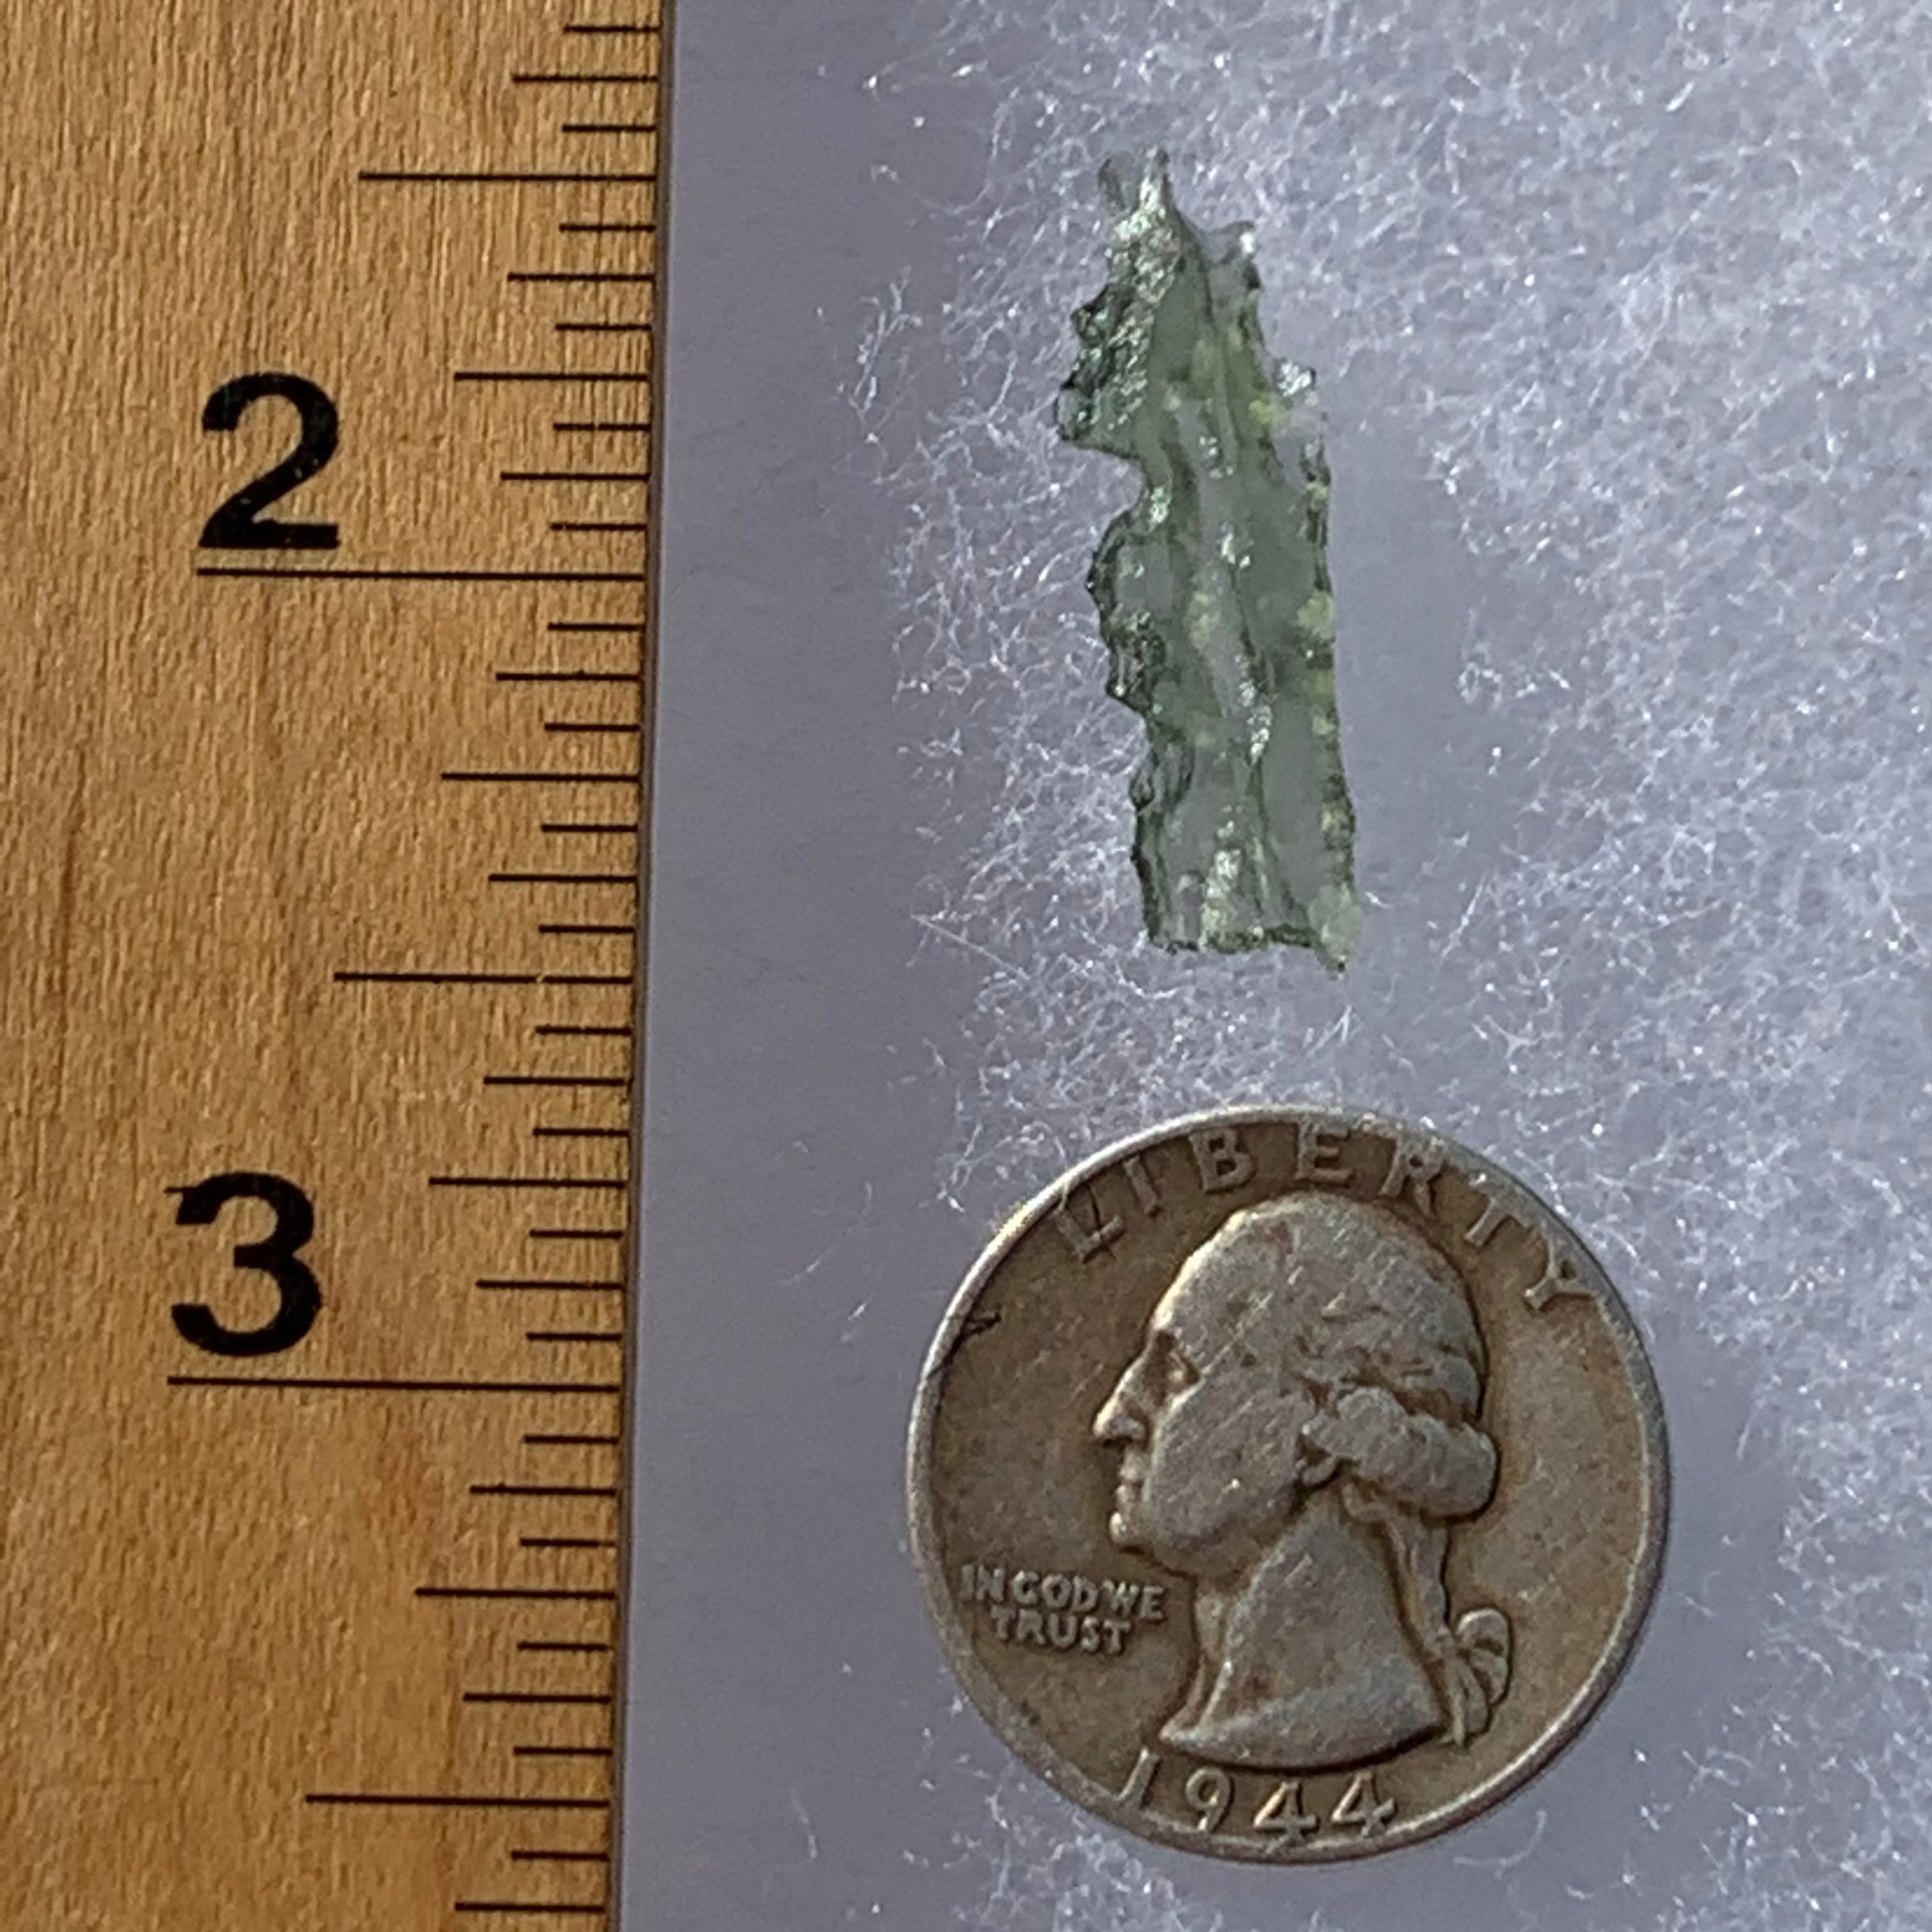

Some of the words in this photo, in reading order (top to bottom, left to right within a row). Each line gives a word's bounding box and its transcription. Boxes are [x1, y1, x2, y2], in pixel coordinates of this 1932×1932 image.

[198, 372, 340, 549] 2
[167, 1171, 323, 1357] 3
[1052, 1122, 1598, 1312] LIBERTY
[959, 1564, 1006, 1603] IN
[1011, 1570, 1098, 1612] GOD
[1102, 1579, 1164, 1620] WE
[991, 1604, 1131, 1654] TRUST
[1117, 1746, 1396, 1853] 1944
